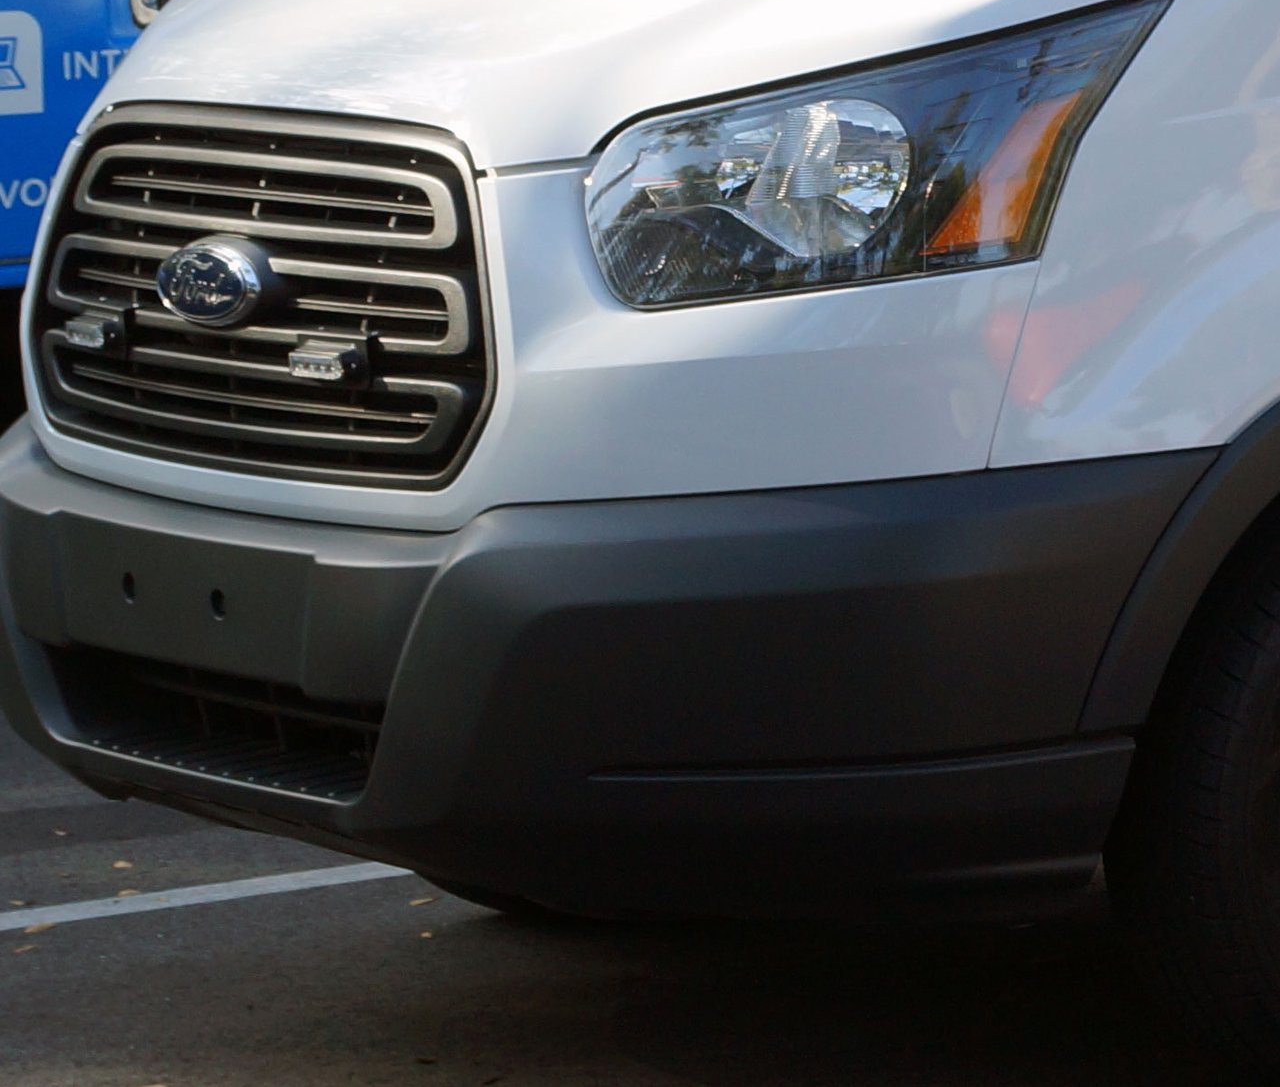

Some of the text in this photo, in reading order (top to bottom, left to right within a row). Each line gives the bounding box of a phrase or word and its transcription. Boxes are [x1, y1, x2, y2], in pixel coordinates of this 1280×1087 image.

[62, 49, 127, 81] INT
[0, 178, 50, 209] VO
[170, 252, 233, 305] Ford
